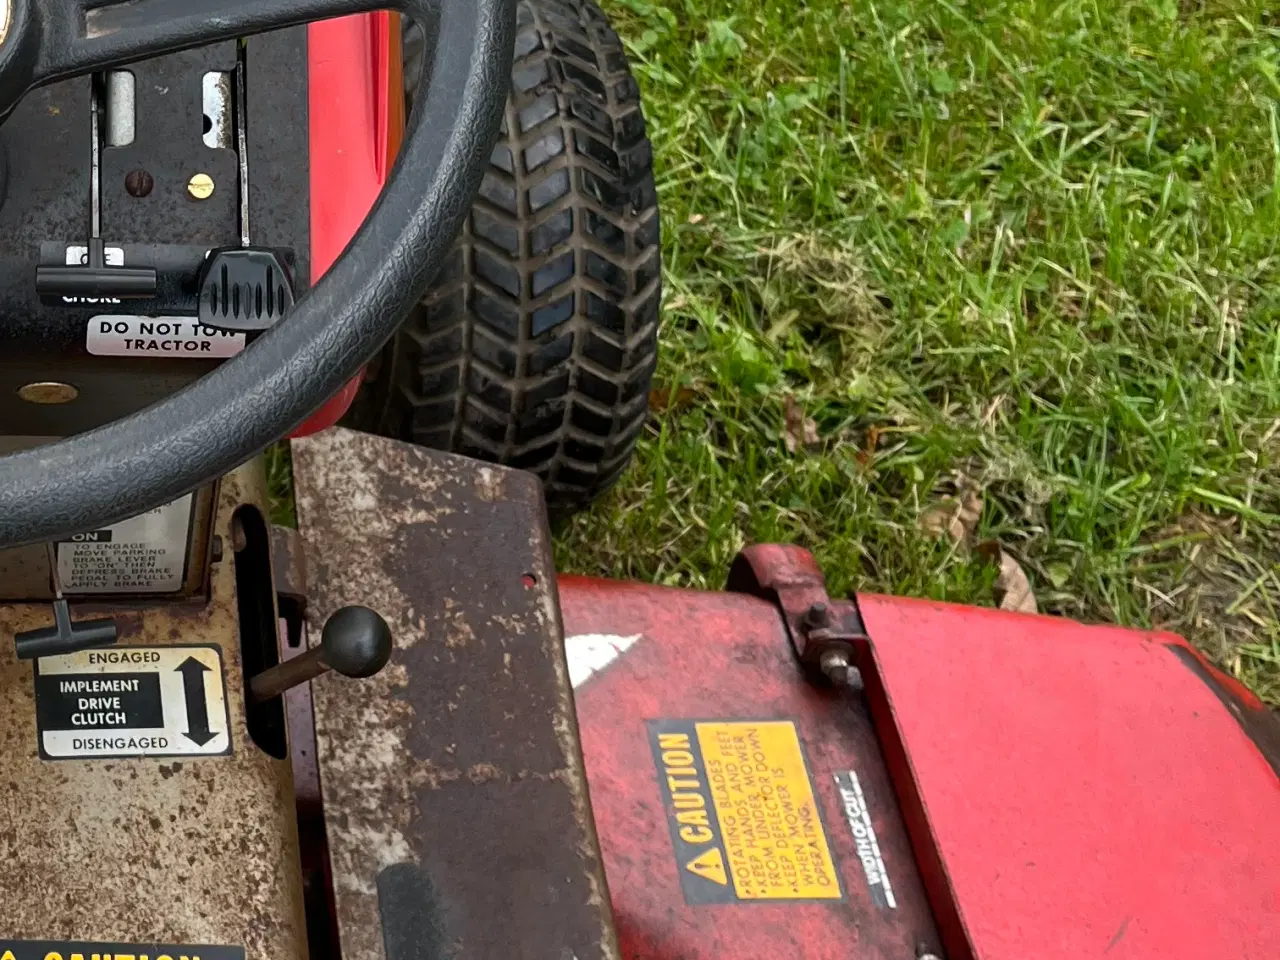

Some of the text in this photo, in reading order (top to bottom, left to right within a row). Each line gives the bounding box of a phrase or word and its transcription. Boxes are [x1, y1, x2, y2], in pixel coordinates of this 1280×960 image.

[100, 321, 129, 334] DO
[139, 322, 182, 336] NOT
[124, 339, 211, 351] TRACTOR
[71, 532, 99, 541] ON
[88, 652, 161, 664] ENGAGED
[60, 679, 139, 693] IMPLEMENT
[78, 697, 121, 710] DRIVE
[71, 712, 127, 725] CLUTCH
[72, 737, 169, 750] DISENGAGED
[657, 733, 714, 843] CAUTION
[715, 730, 767, 888] KEEP HANDS AND FEET
[734, 736, 784, 888] FROM UNDER MOWER
[746, 728, 799, 888] KEEP DEFLECTOR DOWN
[708, 759, 752, 888] ROTATING BLADES
[772, 767, 815, 886] WHEN MOWER IS
[840, 787, 881, 886] WIDTH OF CUT
